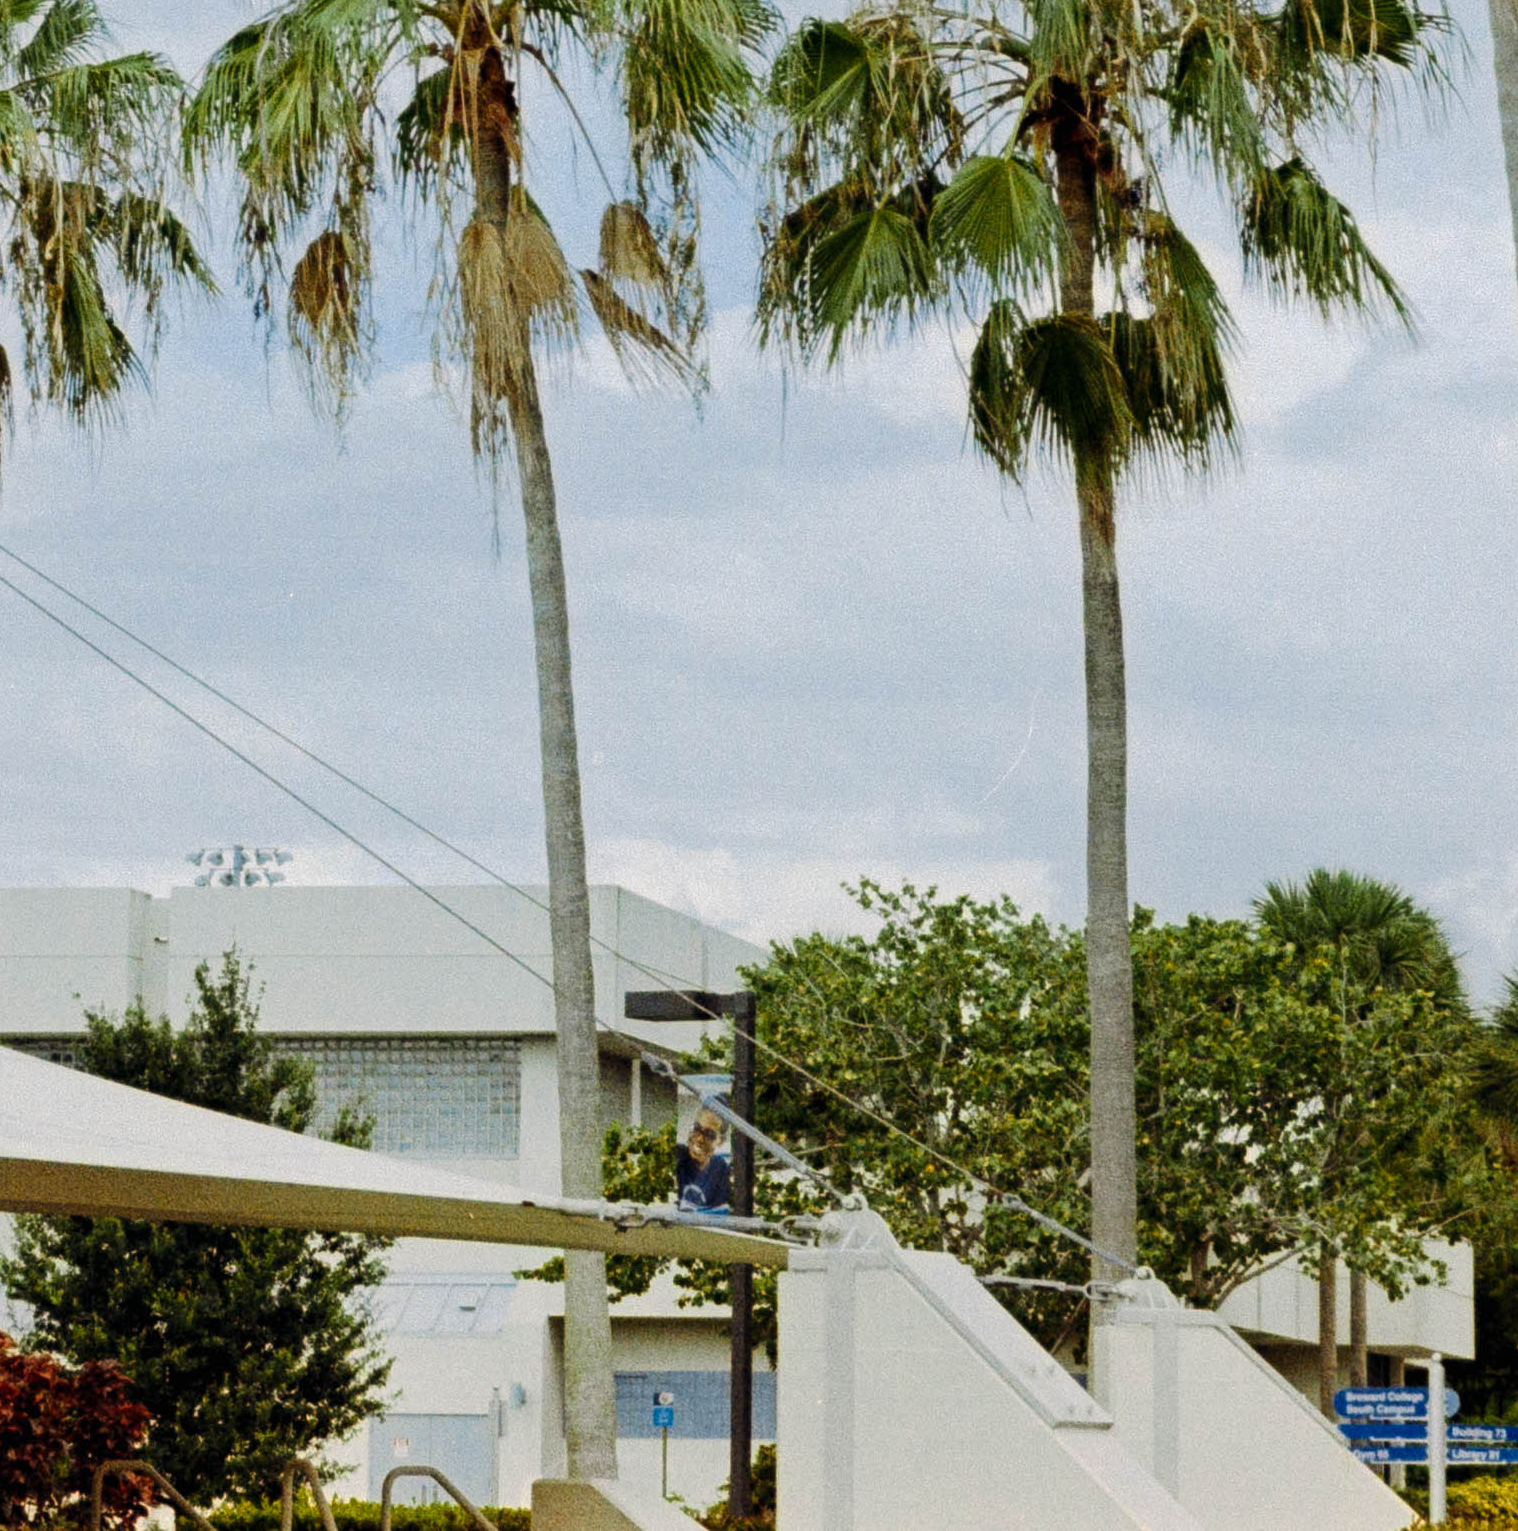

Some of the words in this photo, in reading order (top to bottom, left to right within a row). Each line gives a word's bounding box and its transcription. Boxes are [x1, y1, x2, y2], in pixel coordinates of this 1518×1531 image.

[1346, 1391, 1386, 1402] Broward
[1387, 1391, 1424, 1404] College
[1346, 1405, 1374, 1414] South
[1376, 1404, 1415, 1416] Campus
[1452, 1426, 1492, 1439] Building
[1452, 1449, 1487, 1461] Library
